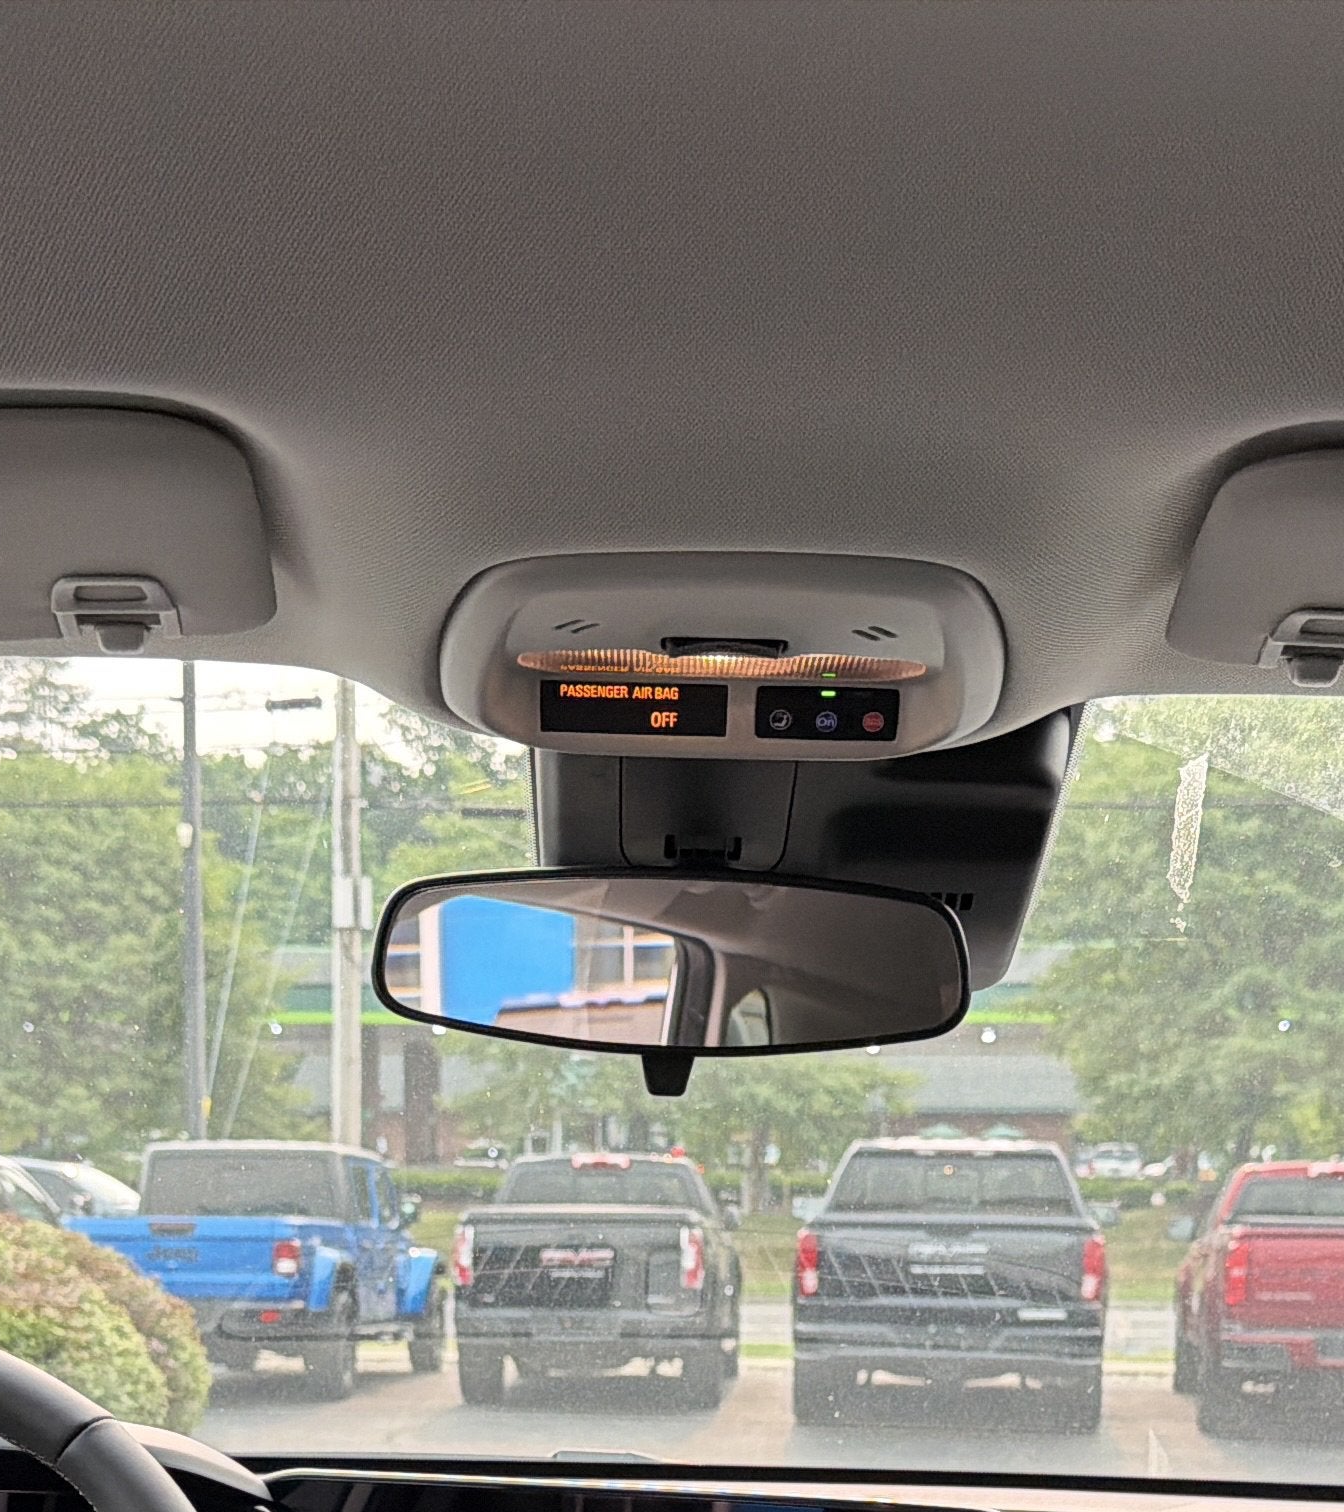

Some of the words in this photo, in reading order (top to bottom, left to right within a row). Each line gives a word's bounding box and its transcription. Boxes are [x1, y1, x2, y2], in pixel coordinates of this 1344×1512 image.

[560, 684, 629, 699] PASSENGER
[632, 686, 653, 699] AIR
[655, 687, 679, 700] BAG
[650, 712, 678, 728] OFF
